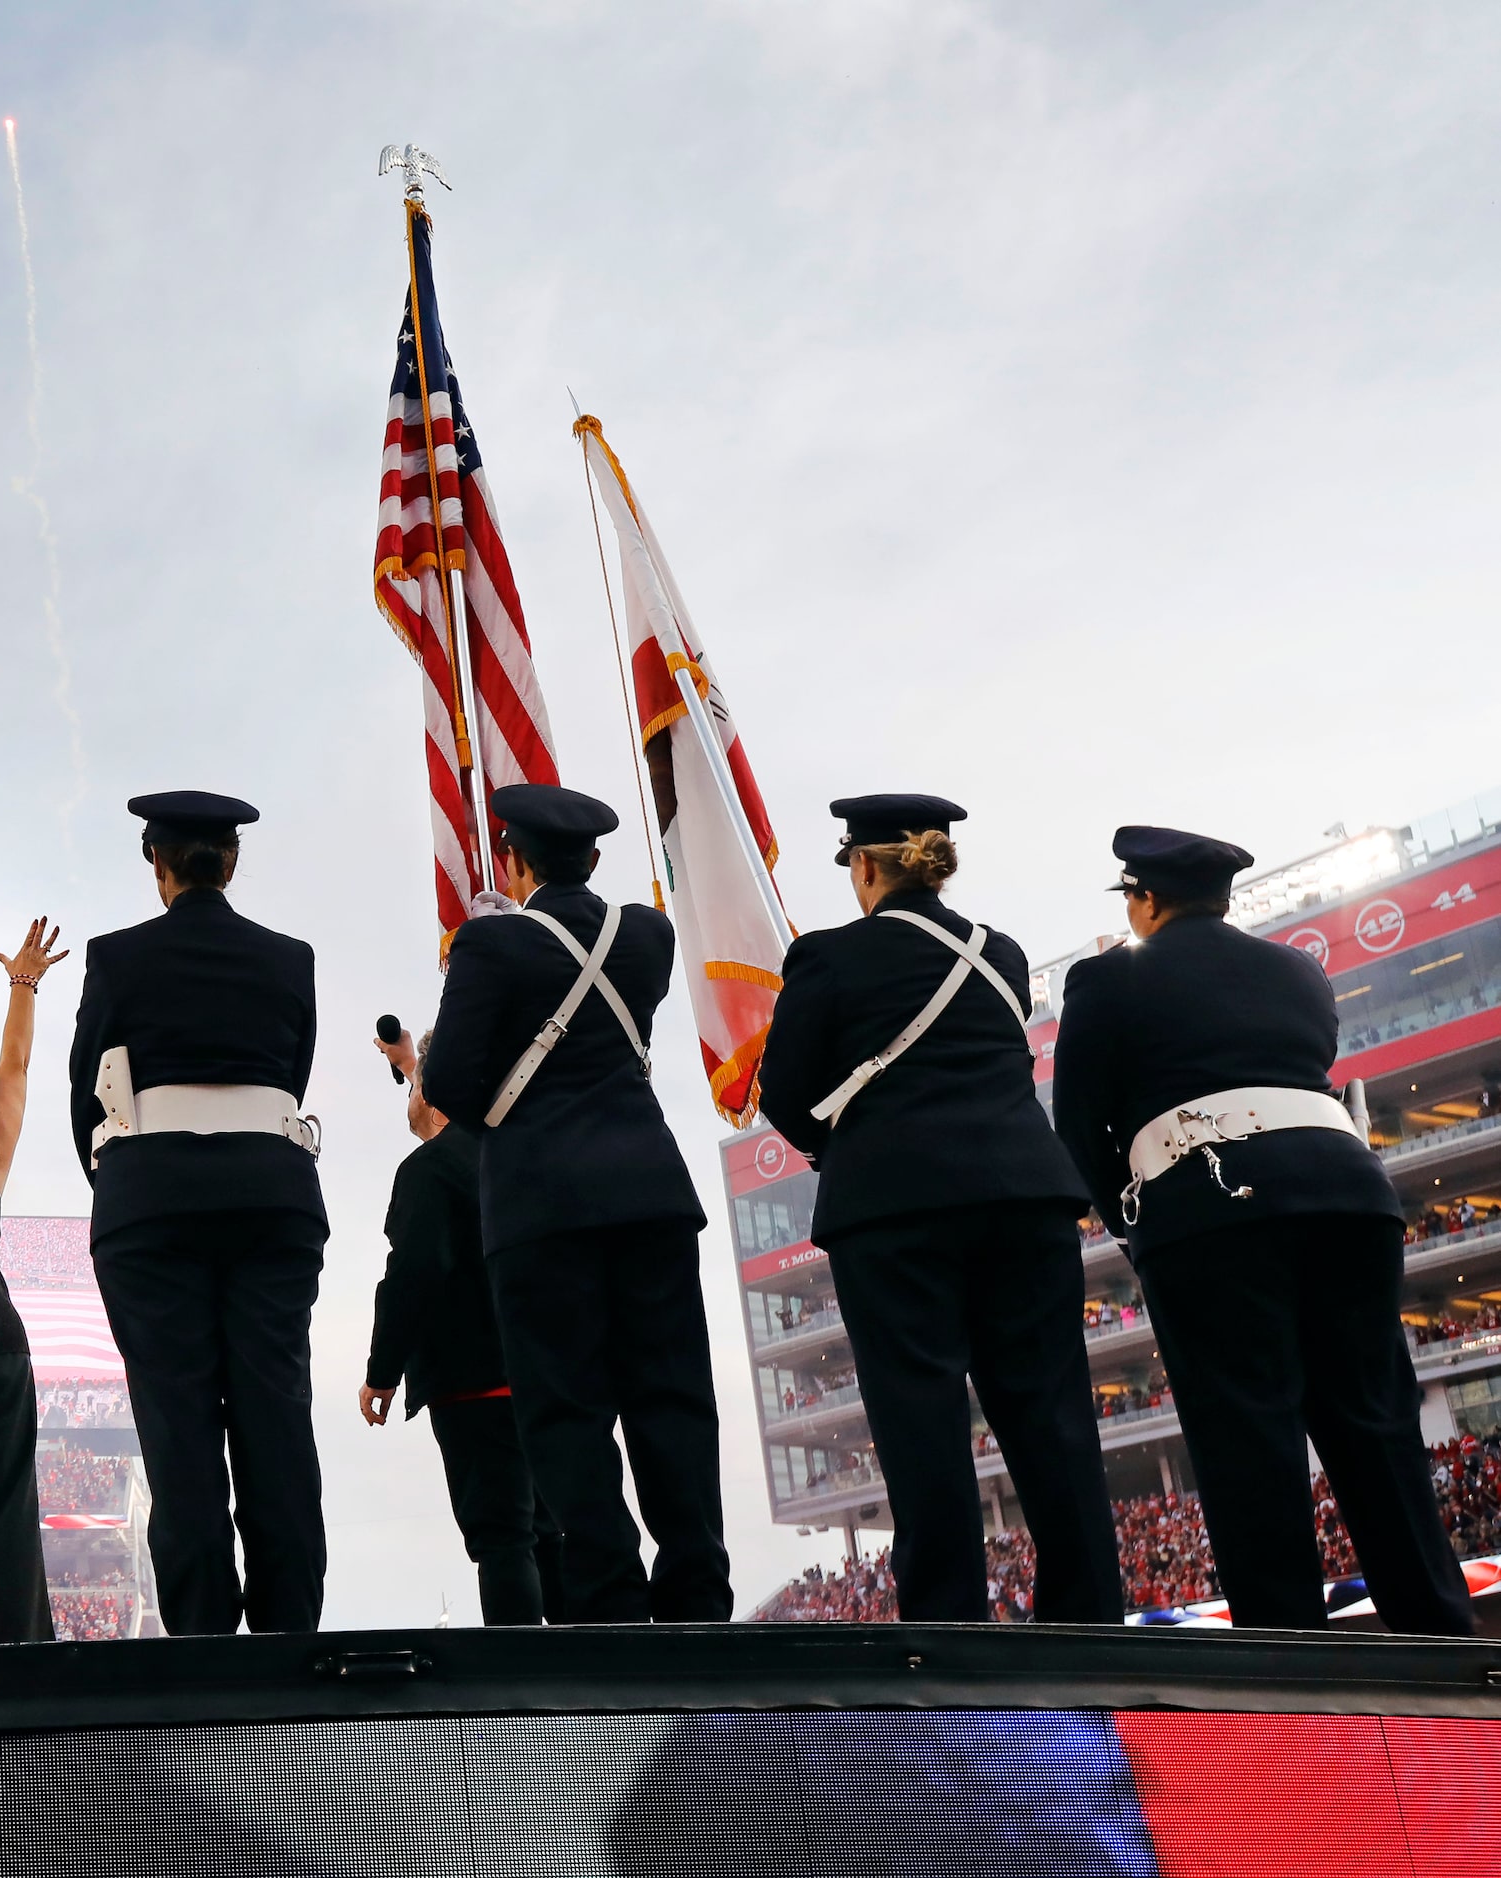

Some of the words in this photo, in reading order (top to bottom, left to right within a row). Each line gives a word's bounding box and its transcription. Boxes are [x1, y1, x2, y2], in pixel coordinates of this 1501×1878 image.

[1430, 883, 1477, 911] 44
[1355, 911, 1401, 938] 42
[778, 1258, 790, 1270] T.
